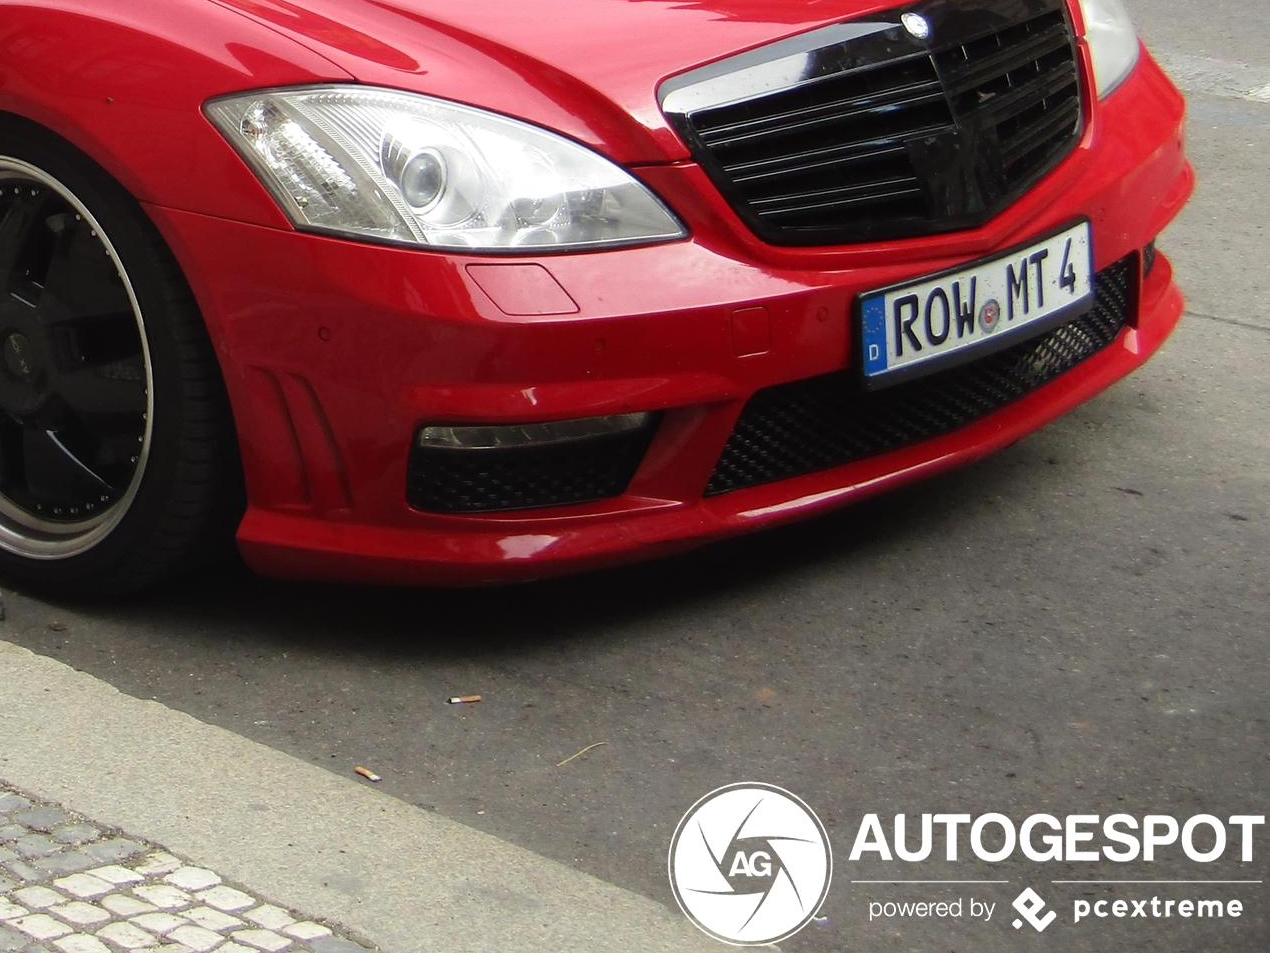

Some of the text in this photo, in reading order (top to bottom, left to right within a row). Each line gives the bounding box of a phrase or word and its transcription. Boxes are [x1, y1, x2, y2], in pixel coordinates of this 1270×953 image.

[894, 237, 1076, 356] ROW MT 4
[869, 344, 879, 361] D
